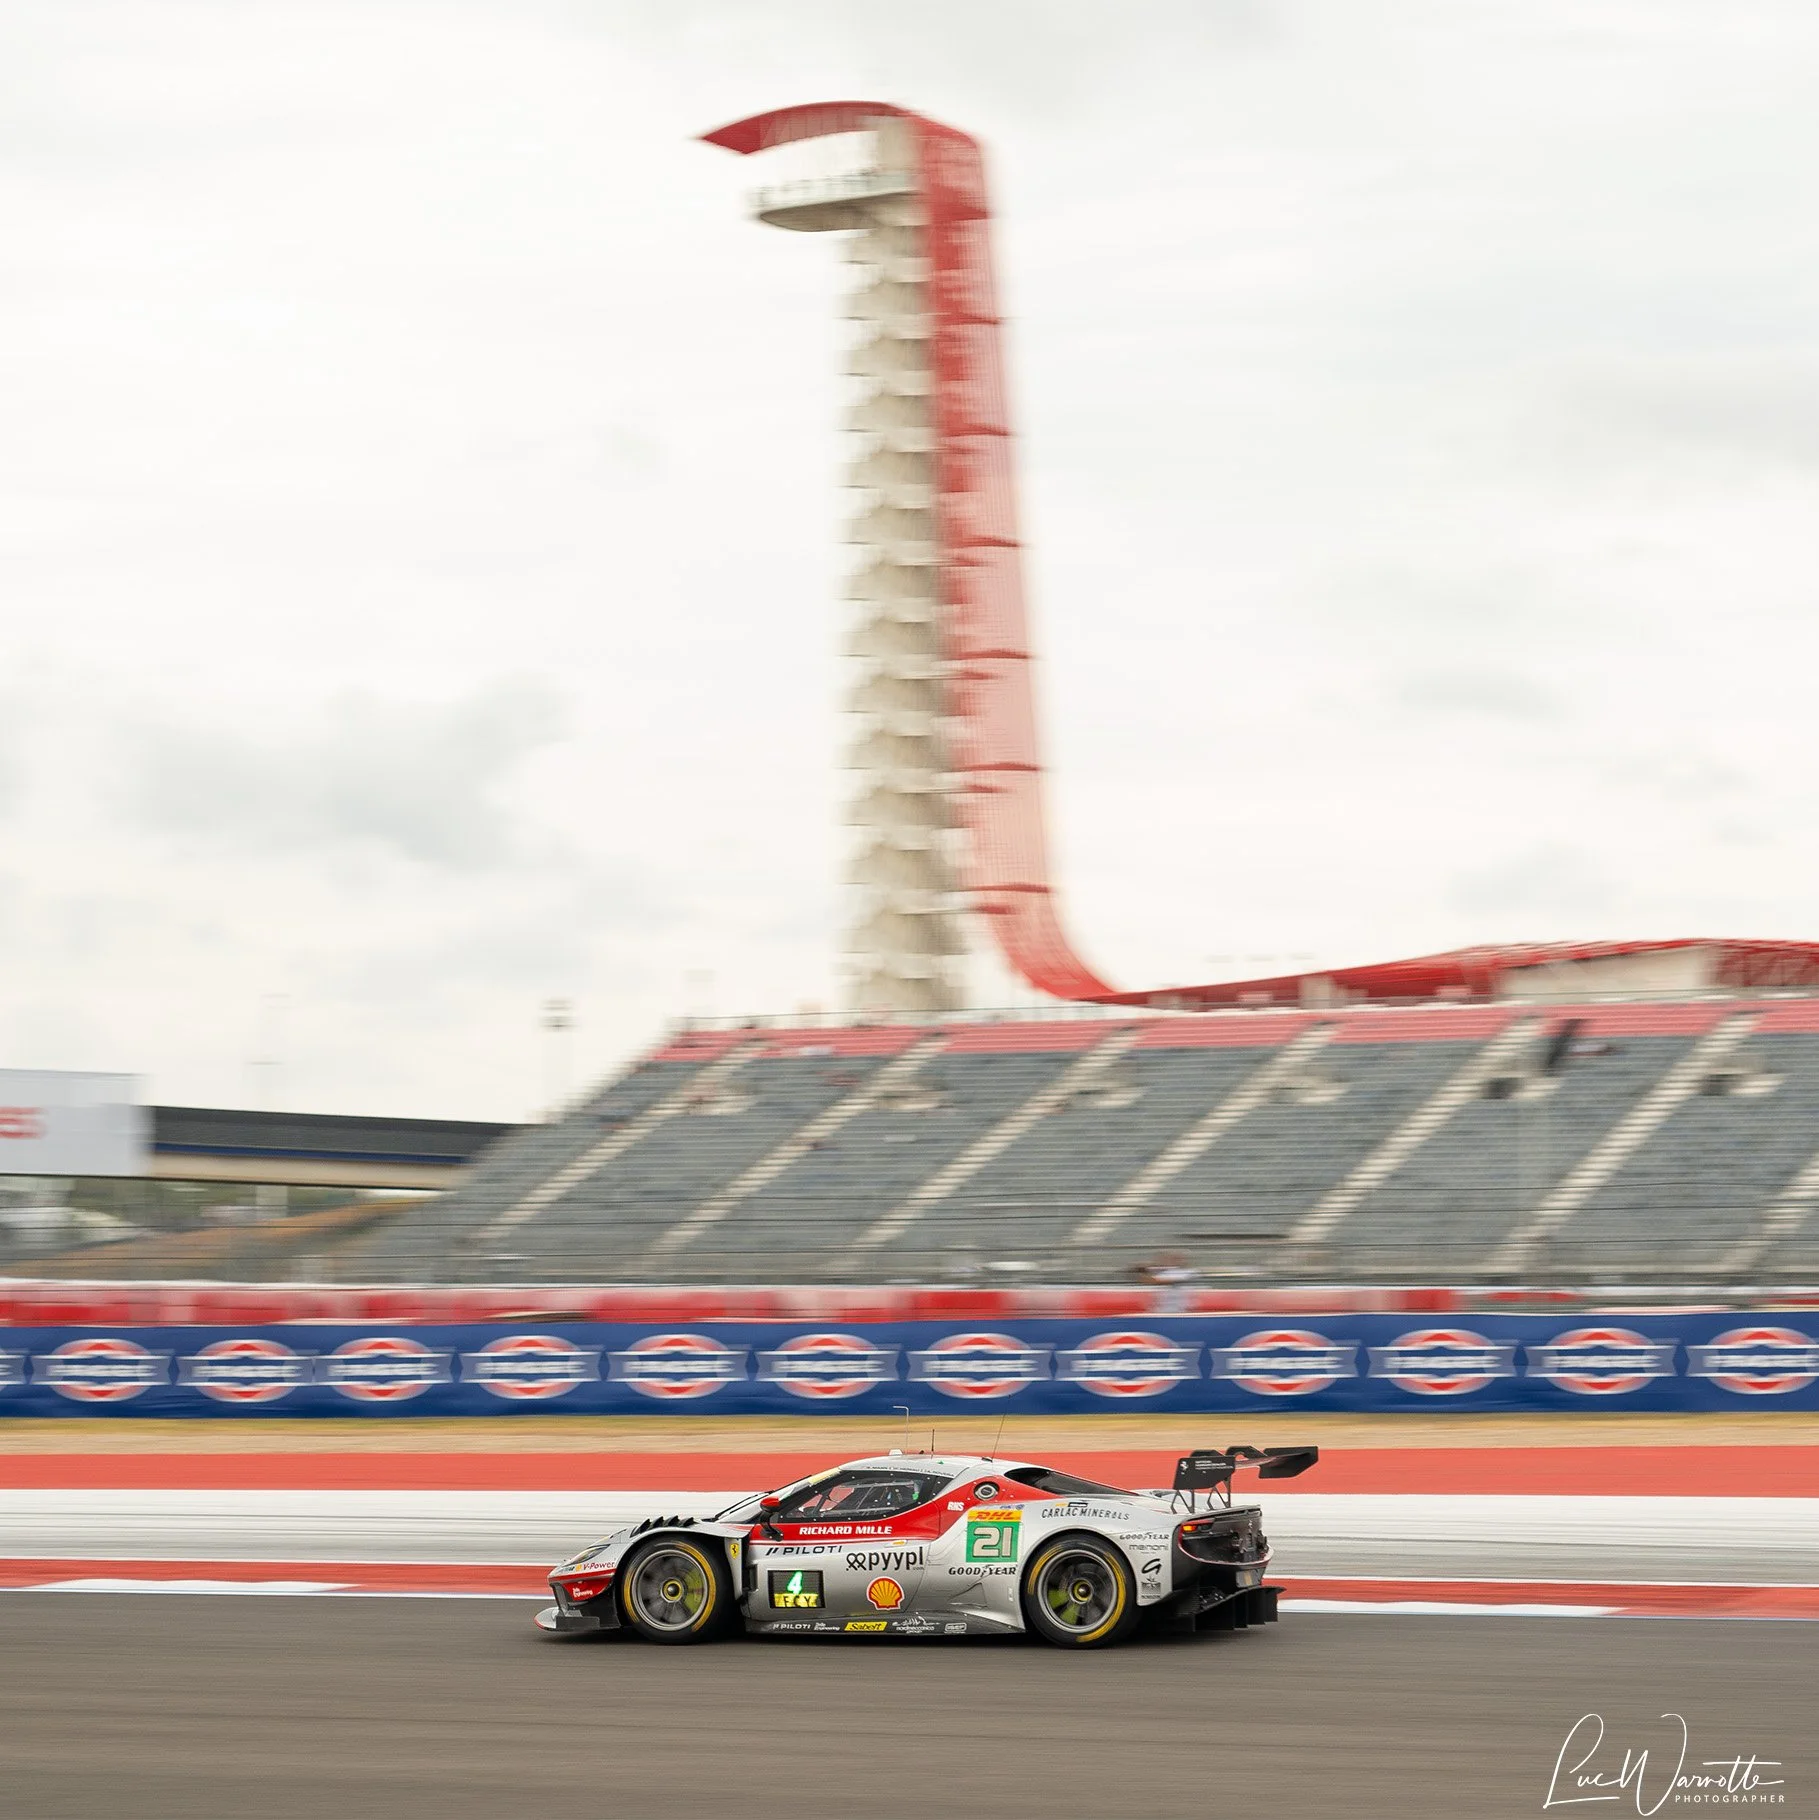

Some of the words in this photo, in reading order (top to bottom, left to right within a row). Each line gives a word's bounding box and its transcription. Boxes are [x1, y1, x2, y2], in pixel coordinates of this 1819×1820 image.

[976, 1511, 1014, 1520] DHL
[799, 1526, 852, 1535] RICHARD
[855, 1526, 893, 1535] MILLE
[973, 1526, 1014, 1558] 21
[783, 1545, 843, 1555] PILOTI
[868, 1546, 924, 1571] pyypl
[583, 1562, 615, 1570] V-Power
[786, 1570, 803, 1595] 4
